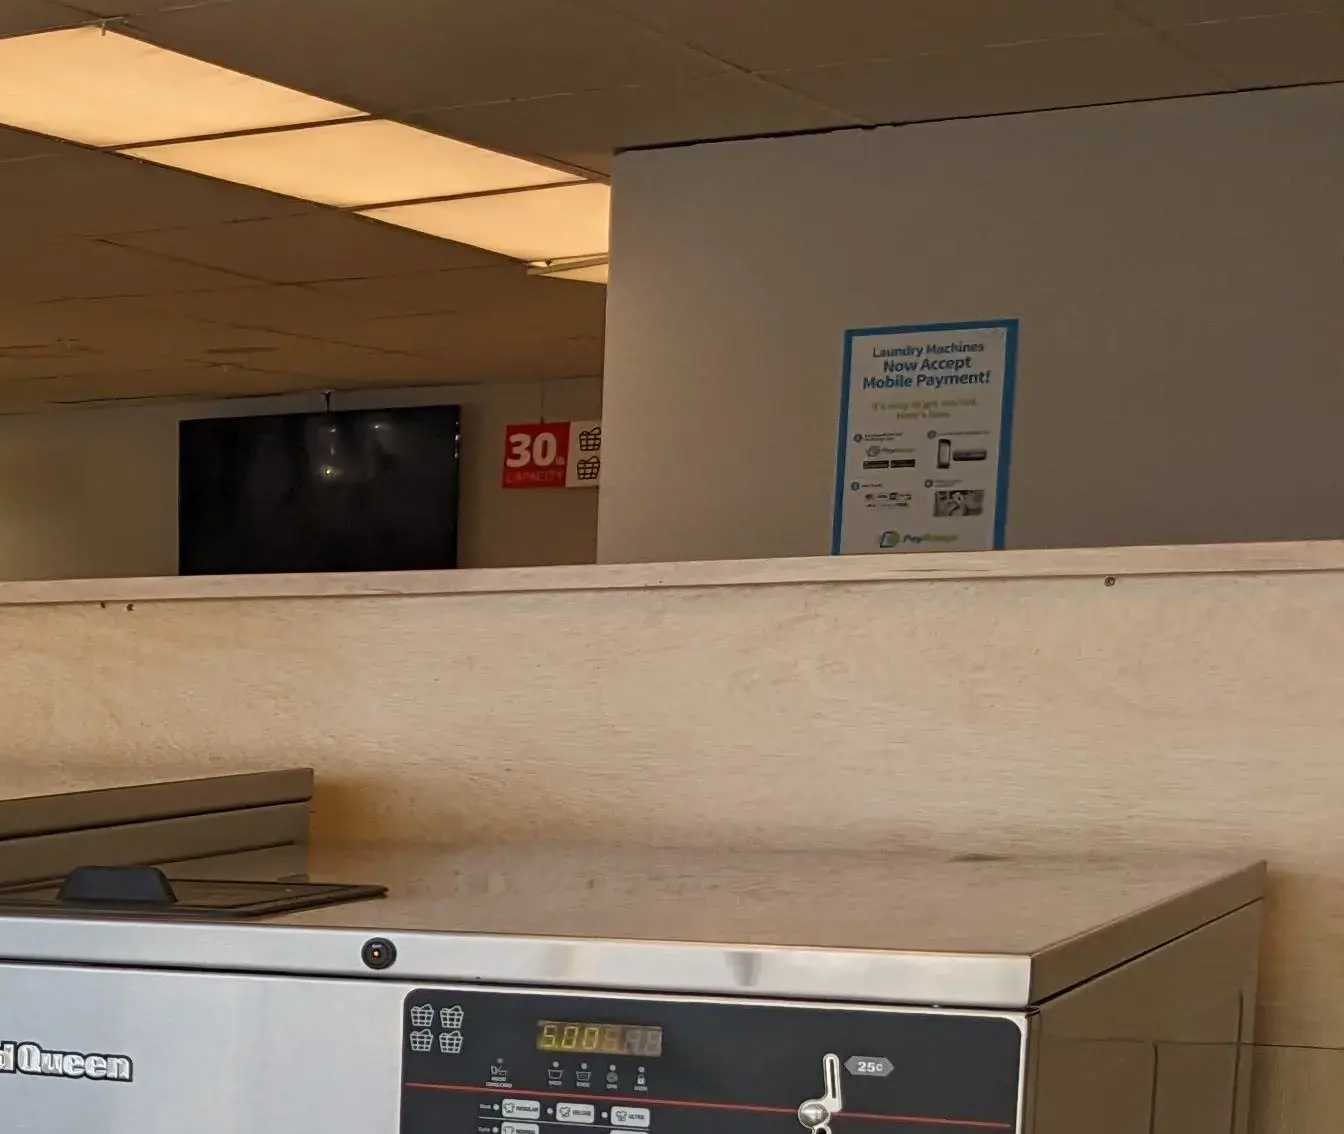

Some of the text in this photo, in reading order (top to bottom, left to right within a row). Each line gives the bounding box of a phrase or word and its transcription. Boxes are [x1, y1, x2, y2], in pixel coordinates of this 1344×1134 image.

[873, 341, 984, 358] Laundry Machines
[883, 356, 972, 373] Now Accept
[863, 369, 991, 390] Mobile Payment!
[506, 432, 557, 467] 30
[16, 1041, 132, 1081] Queen
[857, 1061, 883, 1073] 25¢
